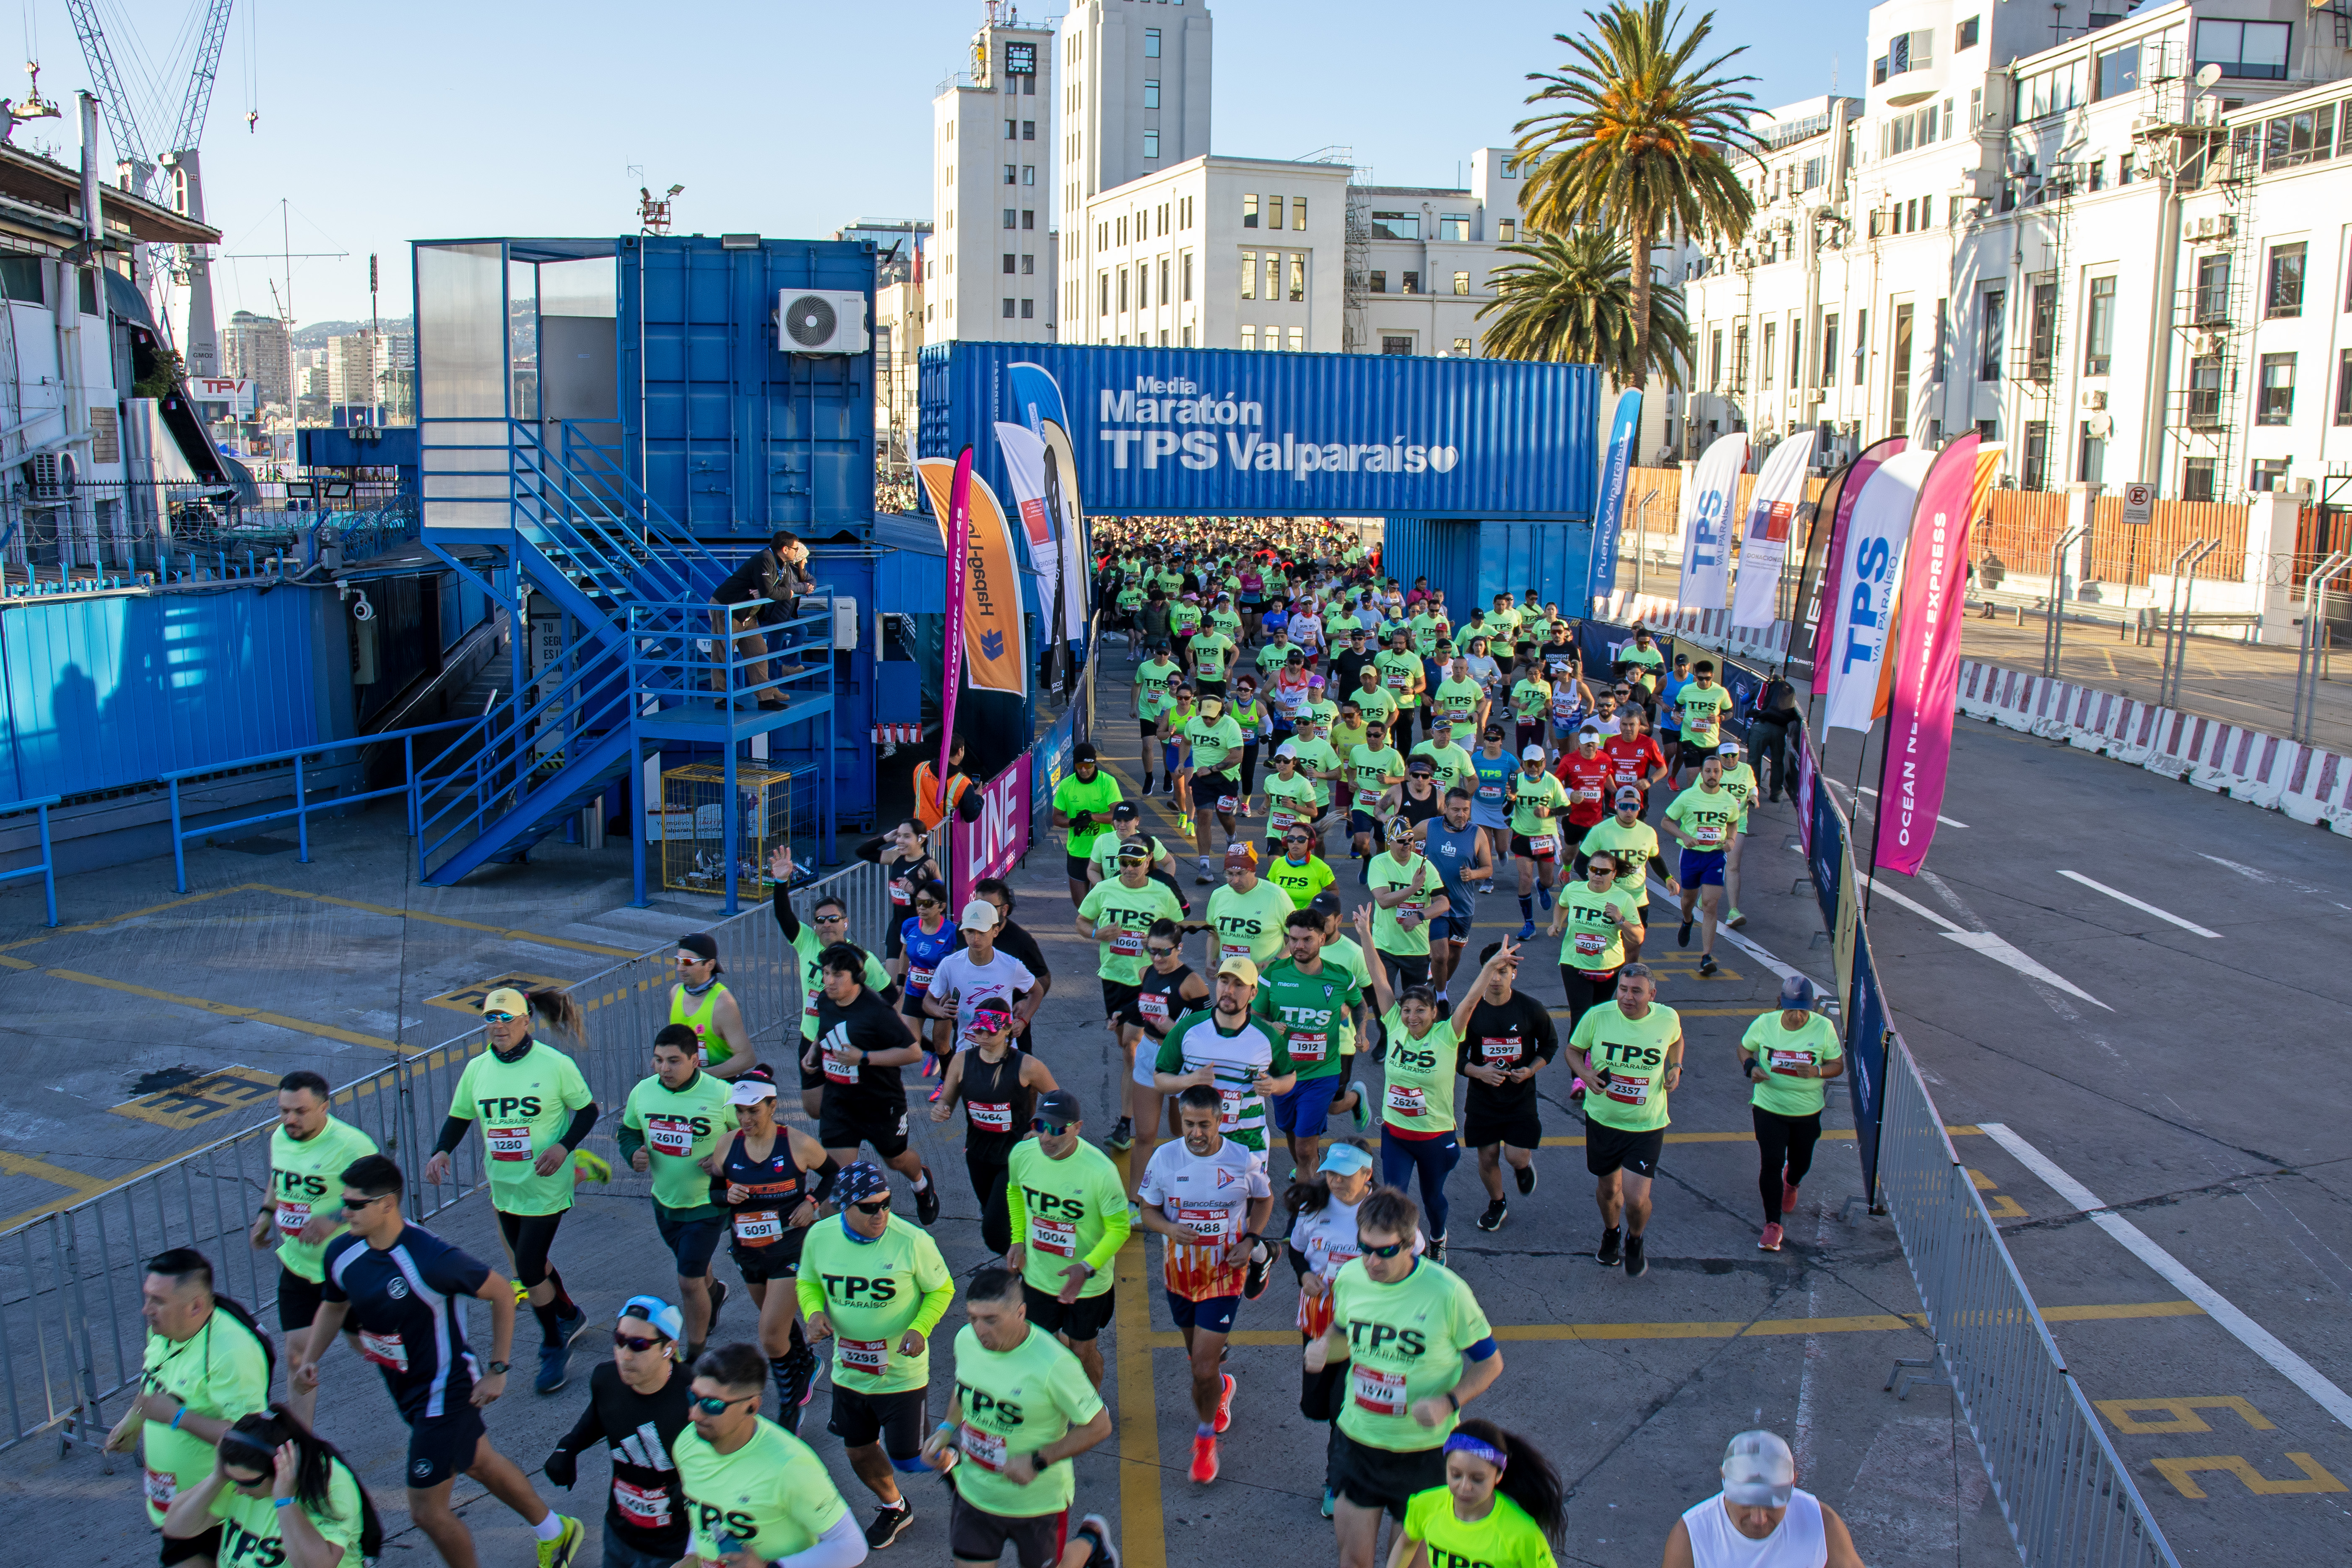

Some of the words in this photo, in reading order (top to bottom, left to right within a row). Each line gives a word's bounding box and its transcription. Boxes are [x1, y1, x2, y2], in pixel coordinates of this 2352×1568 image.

[202, 380, 246, 393] TPV
[1137, 376, 1197, 395] Media
[1100, 390, 1262, 425] Maratón
[1100, 431, 1218, 470] TPS
[1691, 490, 1722, 575] TPS
[1842, 537, 1889, 674] TPS
[543, 623, 553, 632] TU
[544, 650, 554, 659] ES
[1384, 666, 1409, 676] TPS
[1899, 762, 1915, 846] OCEAN
[1926, 512, 1947, 624] EXPRESS
[1523, 691, 1546, 699] TPS
[1688, 701, 1716, 710] TPS
[1315, 713, 1331, 722] PS
[1192, 734, 1220, 747] TPS
[1299, 758, 1318, 769] PS
[1357, 765, 1386, 776] TPS
[1432, 767, 1453, 778] PS
[1480, 769, 1502, 777] TPS
[1518, 796, 1550, 806] TPS
[1693, 811, 1728, 823] TPS
[1609, 850, 1648, 862] TPS
[1279, 876, 1309, 887] TPS
[1106, 908, 1155, 927] TPS
[1219, 916, 1261, 935] TPS
[1575, 919, 1612, 929] VALPARAÍSO
[1280, 1006, 1332, 1025] TPS
[1297, 1043, 1318, 1052] 1912
[1391, 1039, 1436, 1068] TPS
[1489, 1046, 1515, 1055] 2597
[1601, 1041, 1661, 1066] TPS
[1389, 1059, 1431, 1074] VALPARAÍSO
[1605, 1060, 1653, 1071] VALPARAÍSO
[1614, 1084, 1641, 1096] 2357
[478, 1096, 541, 1118] TPS
[1393, 1097, 1419, 1108] 2624
[486, 1116, 533, 1125] VALPARAÍSO
[675, 1123, 692, 1131] 10K
[494, 1140, 522, 1149] 1280
[655, 1133, 683, 1144] 2610
[271, 1168, 328, 1196] TPS
[1023, 1185, 1085, 1220] TPS
[745, 1224, 772, 1235] 6091
[1057, 1223, 1073, 1232] 10K
[1037, 1230, 1068, 1244] 1004
[822, 1273, 897, 1300] TPS
[832, 1297, 887, 1309] VALPARAÍSO
[1347, 1319, 1426, 1355] TPS
[845, 1350, 878, 1364] 3298
[957, 1381, 1024, 1425] TPS
